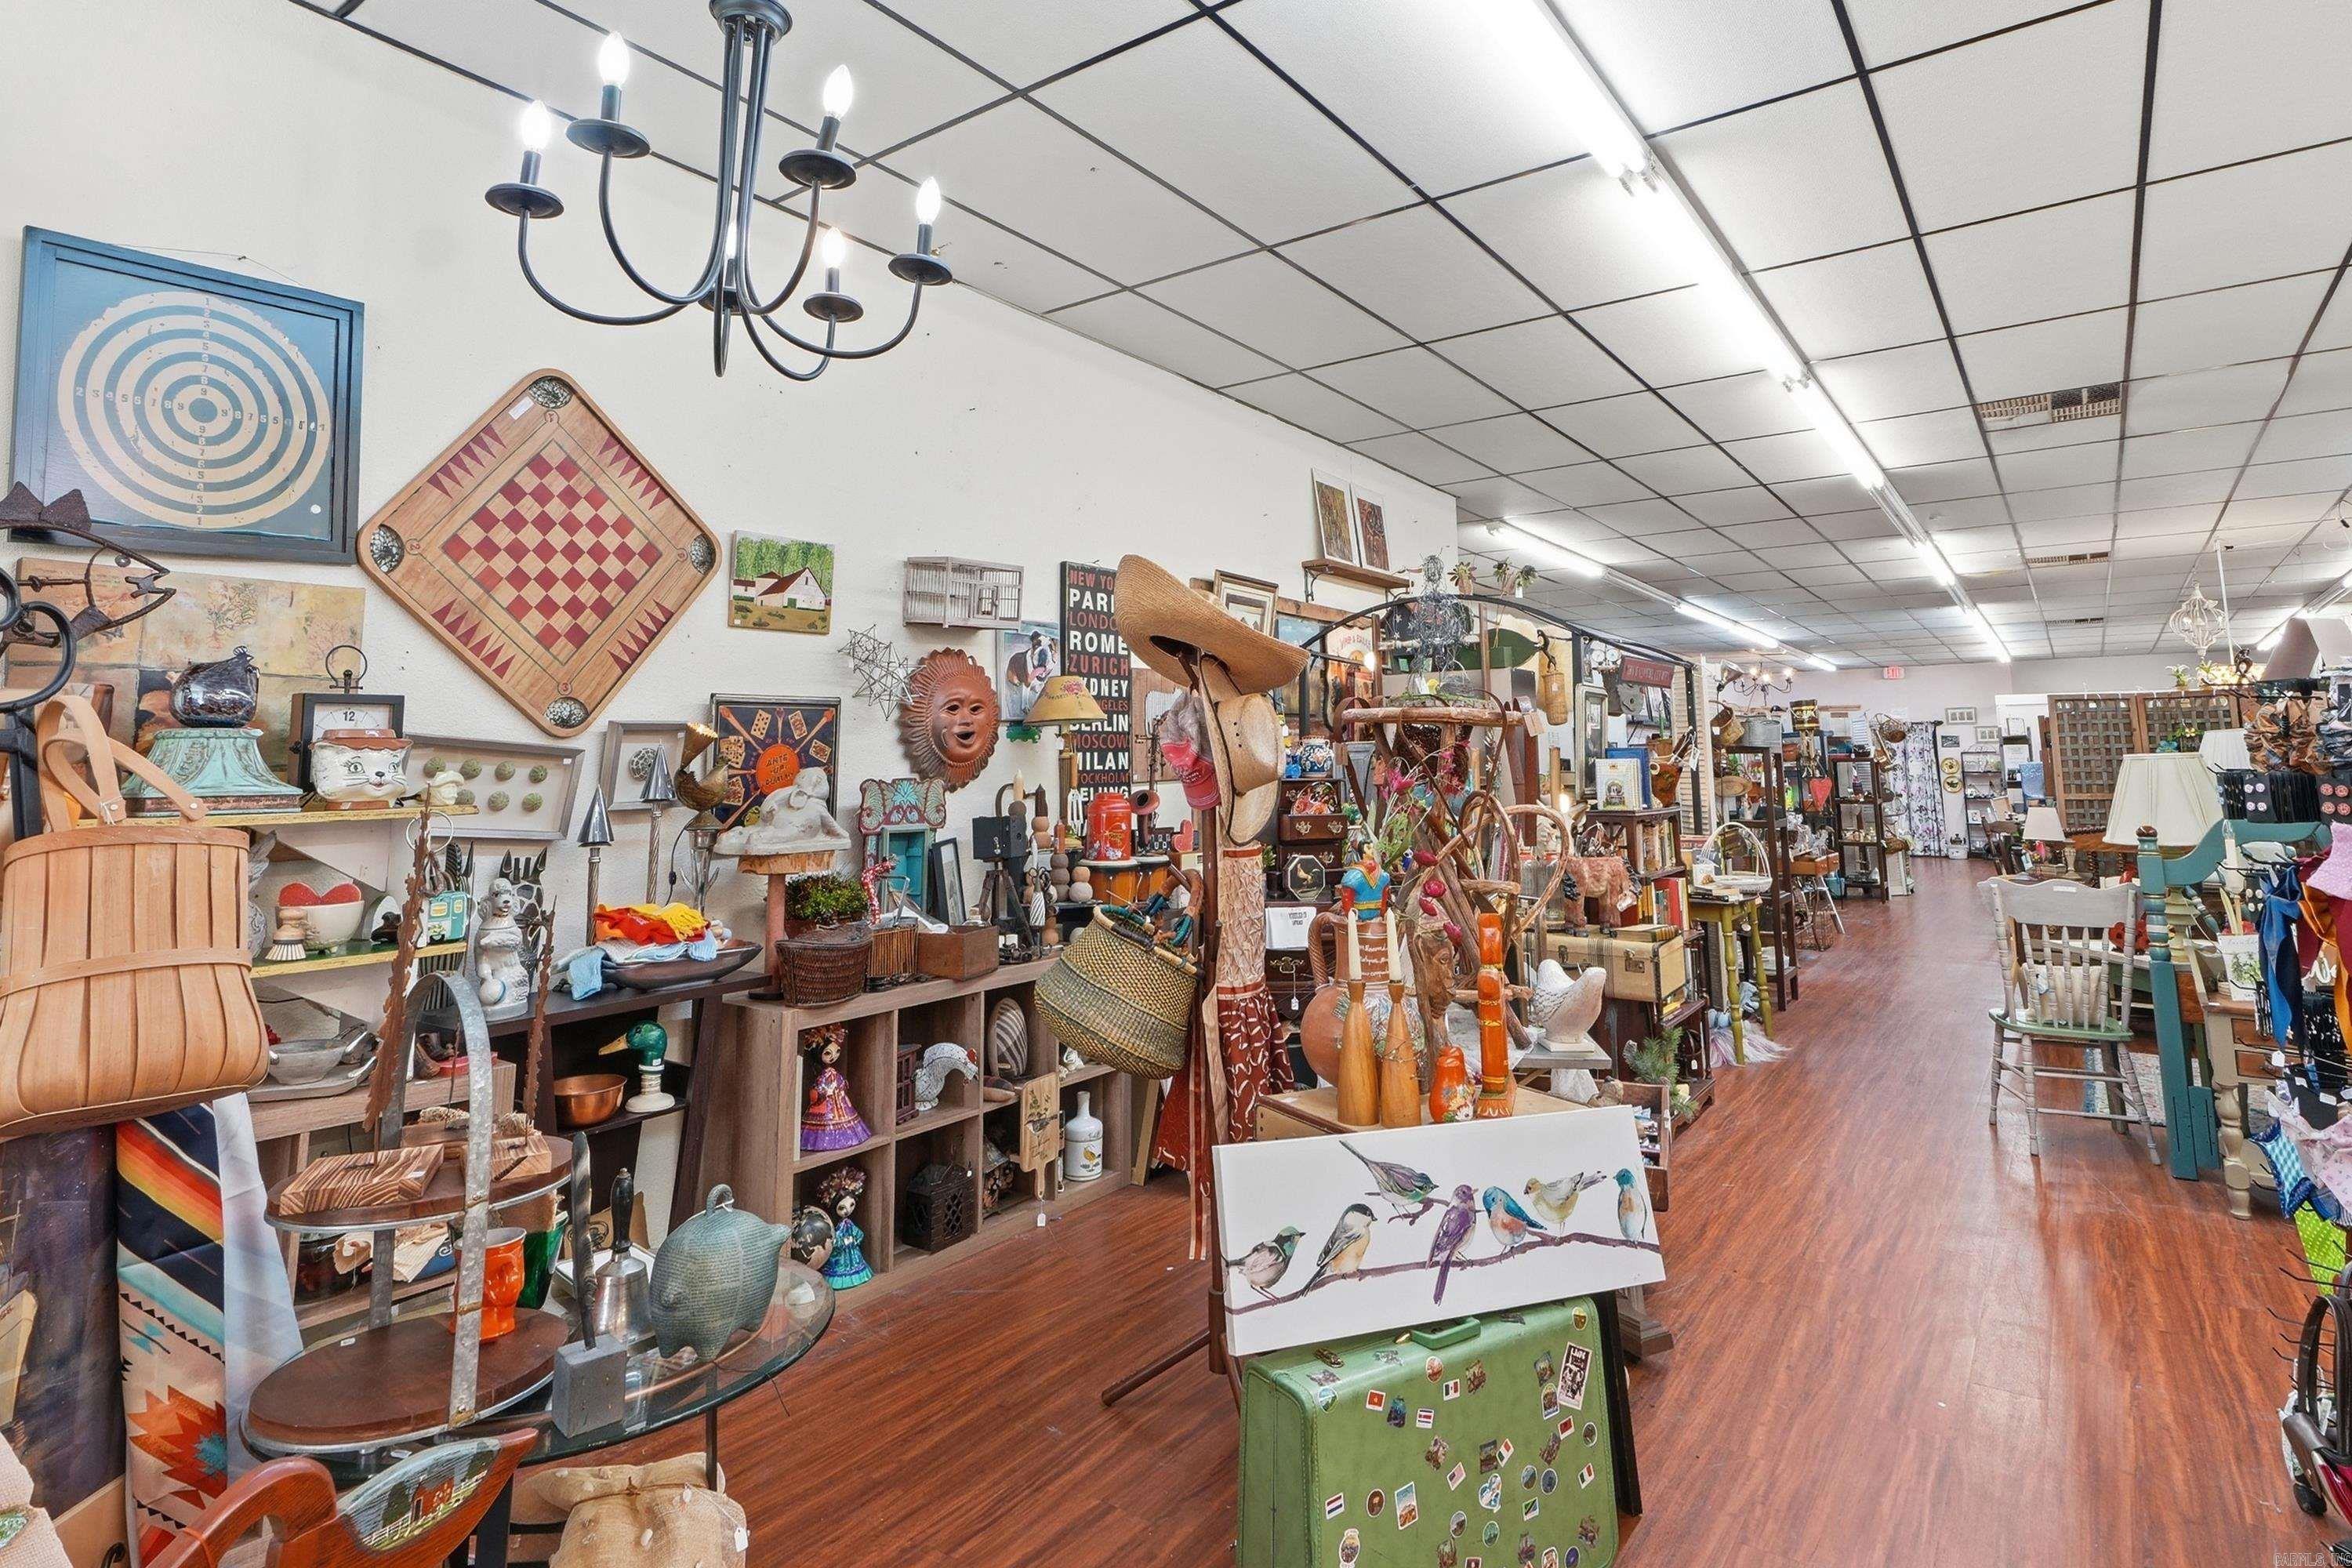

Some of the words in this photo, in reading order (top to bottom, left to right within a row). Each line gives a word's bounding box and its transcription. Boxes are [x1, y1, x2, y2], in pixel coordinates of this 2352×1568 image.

[76, 387, 83, 397] 2
[1069, 570, 1095, 588] NEW
[1100, 575, 1114, 591] YO
[1069, 588, 1115, 614] PARI
[1069, 612, 1119, 631] LONDO
[1069, 630, 1129, 655] ROME
[1069, 654, 1130, 677] ZURICH
[1081, 677, 1129, 698] YDNEY
[343, 711, 355, 721] 12
[1080, 771, 1131, 784] OCKHOLM
